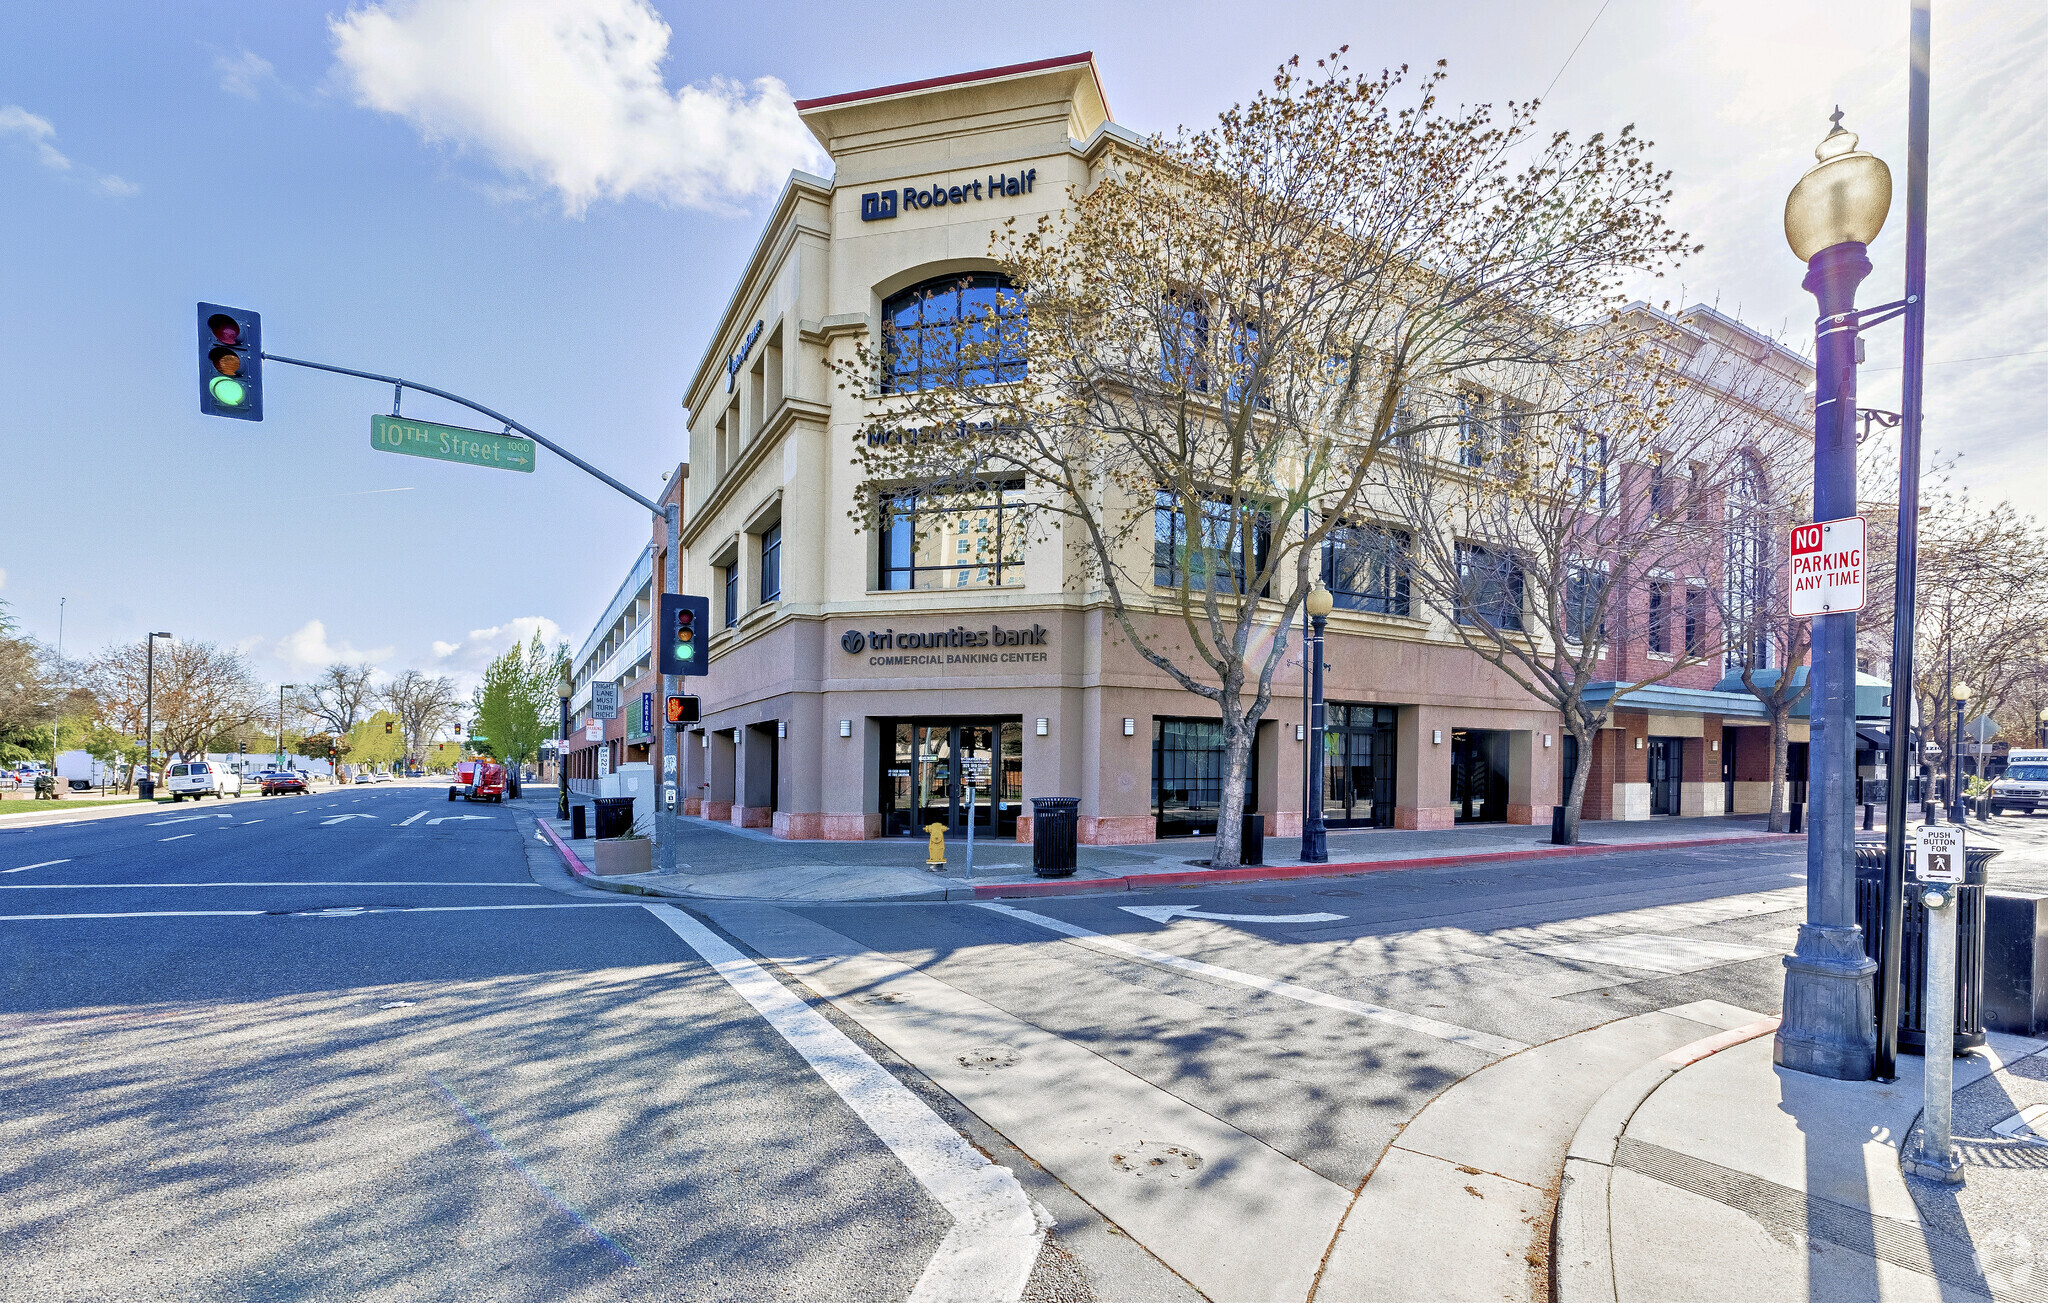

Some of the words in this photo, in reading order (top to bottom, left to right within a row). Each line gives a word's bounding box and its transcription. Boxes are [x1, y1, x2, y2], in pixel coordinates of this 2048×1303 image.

[903, 179, 982, 210] Robert
[988, 168, 1037, 199] Half
[379, 423, 428, 446] 10TH
[439, 432, 500, 461] Street
[507, 442, 530, 453] 1000
[1796, 528, 1820, 549] NO
[1794, 550, 1860, 574] PARKING
[1795, 574, 1823, 591] ANY
[1827, 570, 1860, 587] TIME
[868, 628, 893, 650] tri
[895, 626, 989, 649] counties
[992, 624, 1048, 647] bank
[869, 655, 944, 666] COMMERCIAL
[946, 653, 998, 664] BANKING
[1000, 652, 1048, 663] CENTER
[1923, 838, 1956, 846] BUTTON
